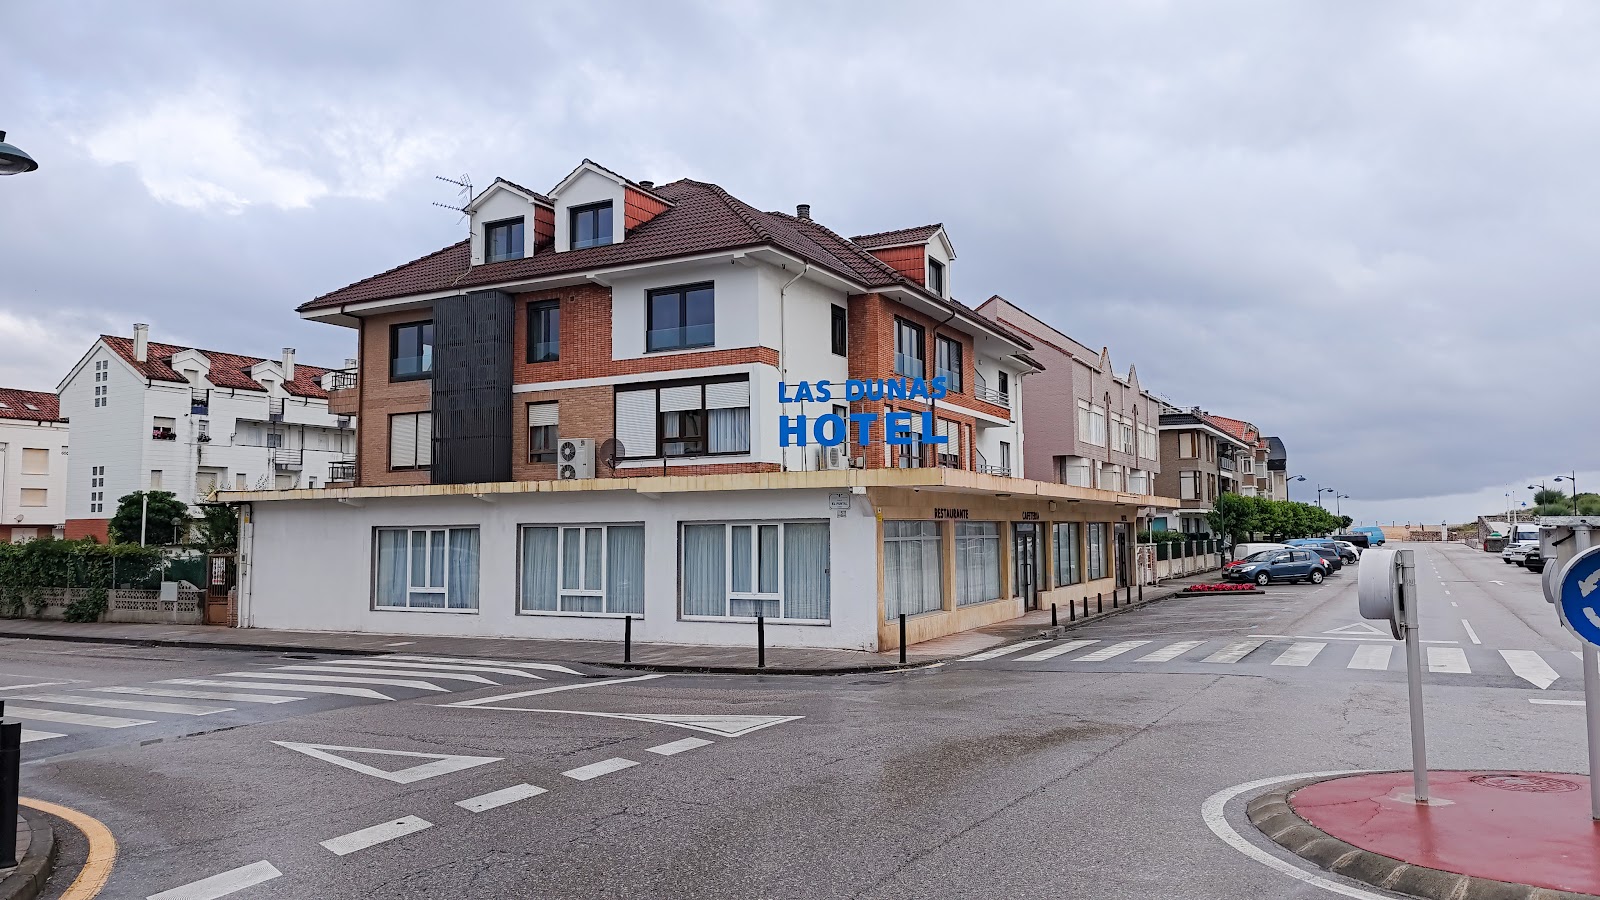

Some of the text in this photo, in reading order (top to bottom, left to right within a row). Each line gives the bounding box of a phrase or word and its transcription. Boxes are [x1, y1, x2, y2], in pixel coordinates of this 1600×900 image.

[779, 376, 947, 403] LAS DUNAS
[779, 412, 948, 448] HOTEL
[934, 508, 968, 519] RESTAURANTE
